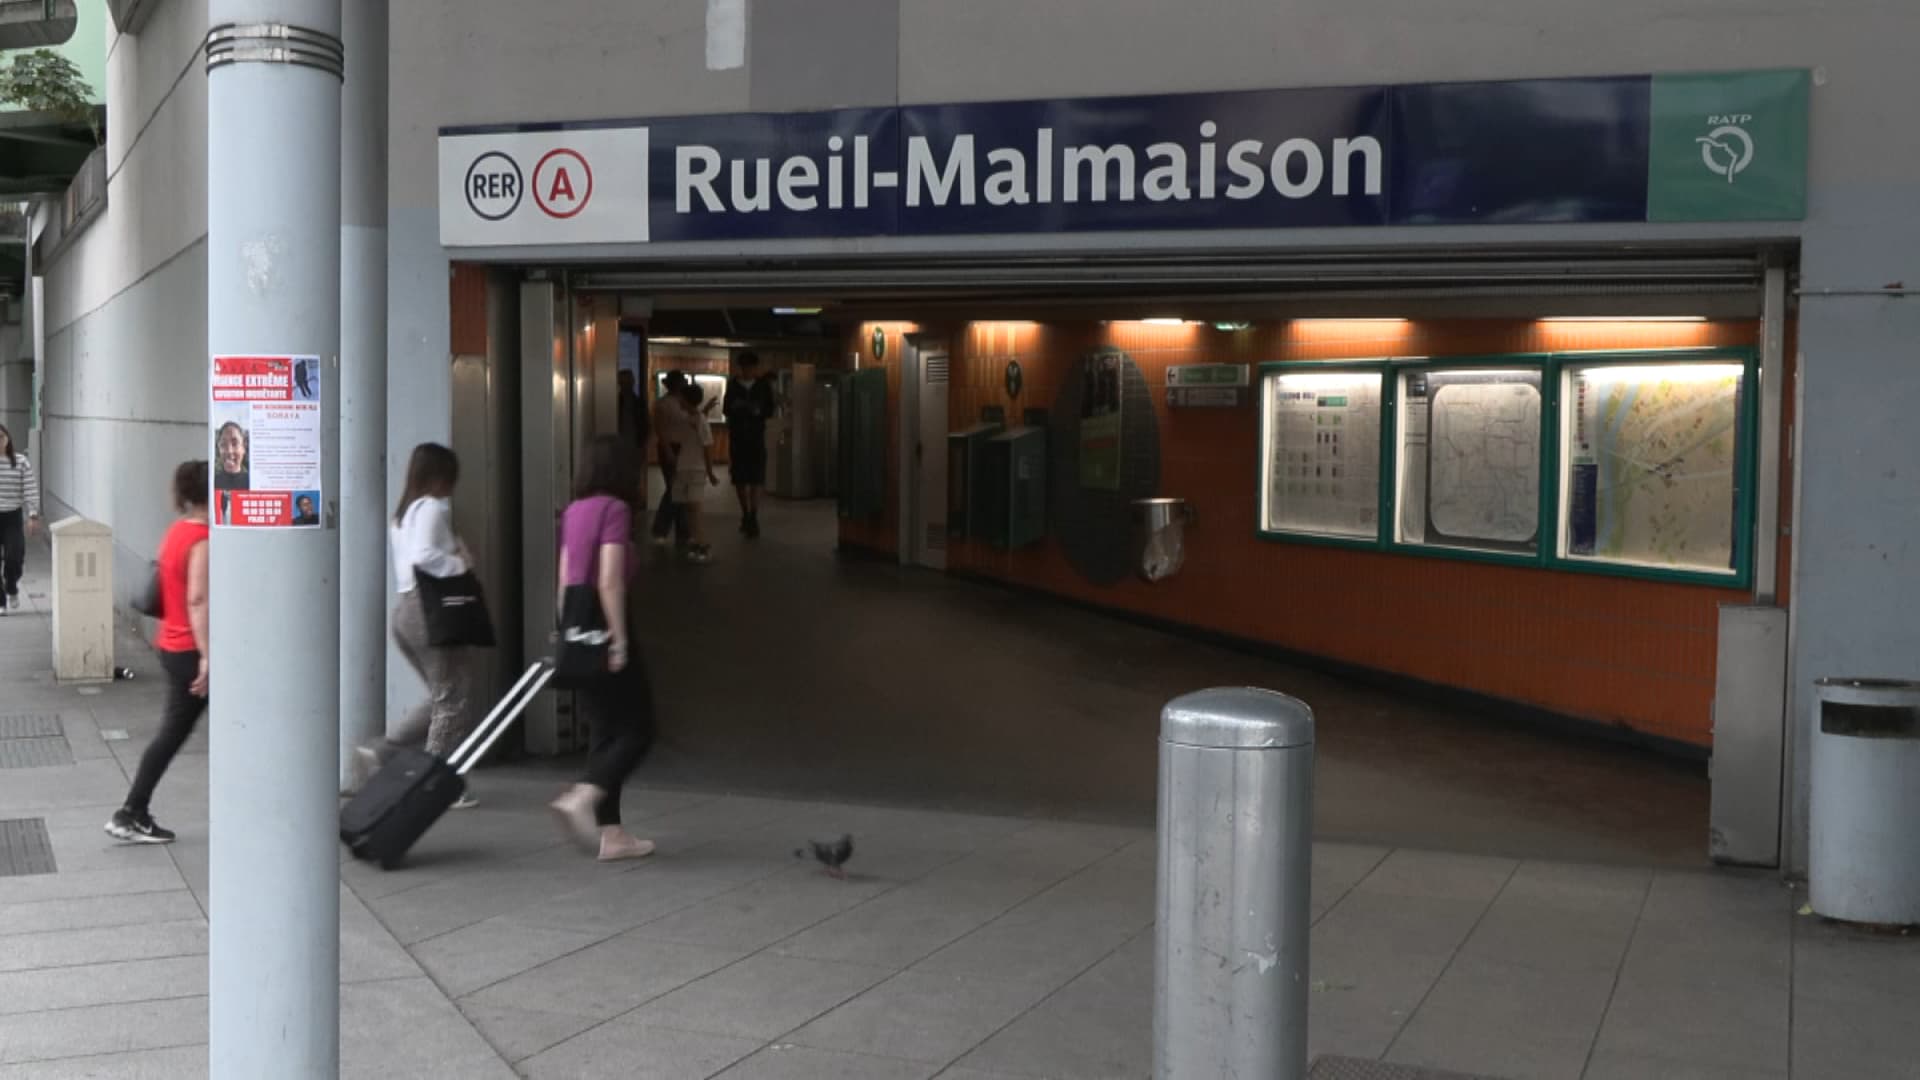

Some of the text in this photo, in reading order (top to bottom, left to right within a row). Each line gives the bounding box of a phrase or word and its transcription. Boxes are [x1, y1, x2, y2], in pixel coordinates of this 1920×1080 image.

[1707, 114, 1752, 125] RATP
[675, 120, 1382, 213] Rueil-Malmaison
[473, 171, 515, 199] RER
[548, 167, 576, 201] A
